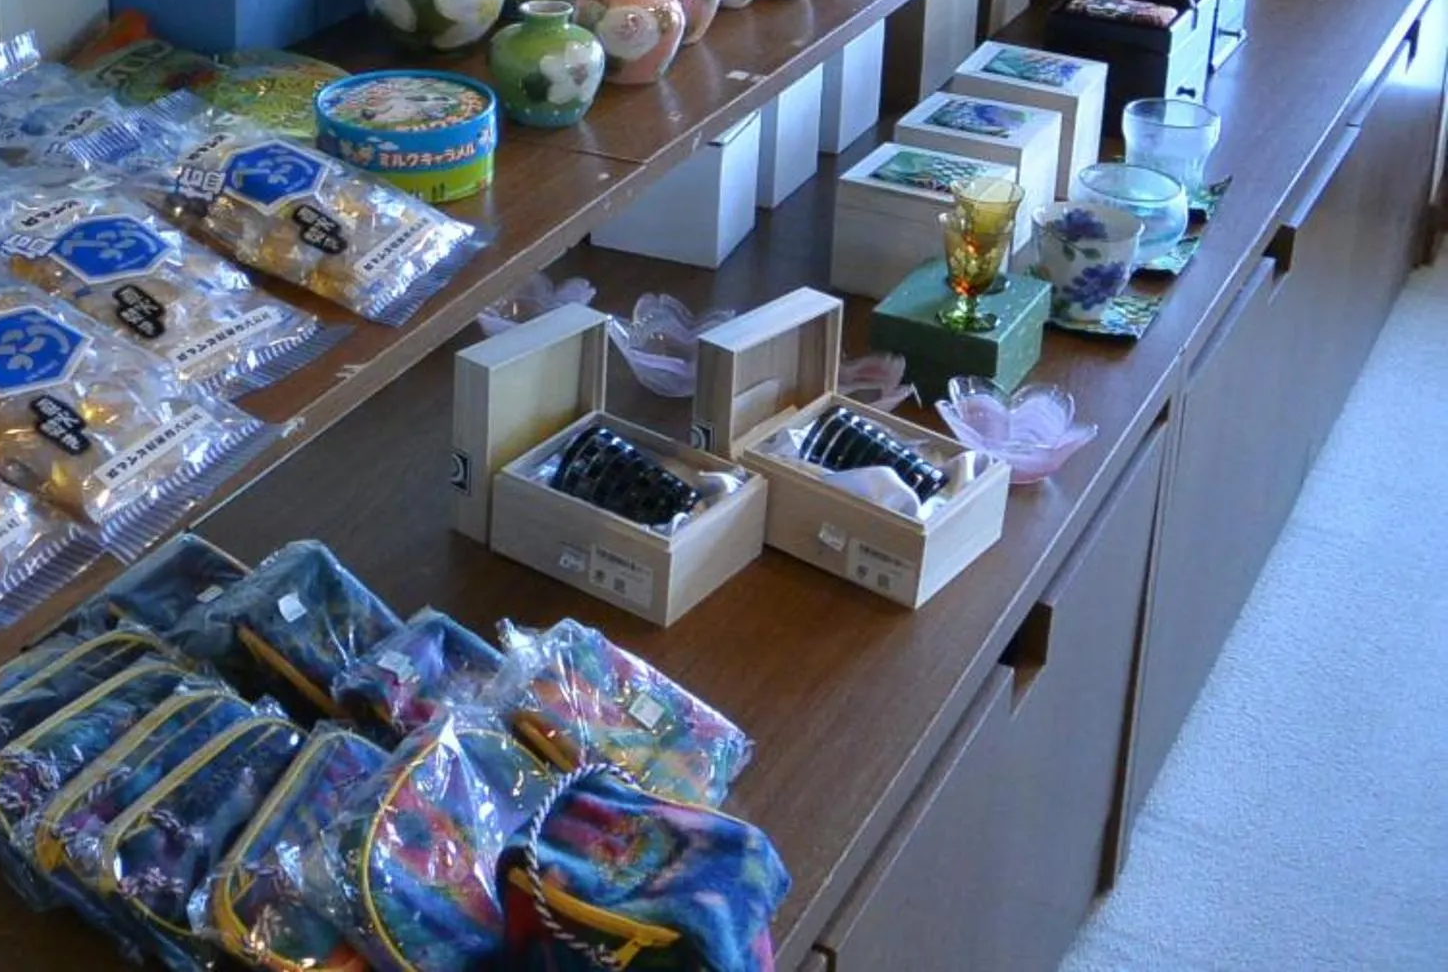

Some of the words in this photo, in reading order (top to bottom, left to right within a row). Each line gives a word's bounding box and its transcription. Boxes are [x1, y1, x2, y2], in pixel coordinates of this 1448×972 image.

[379, 141, 476, 168] ミルクキャラメル
[178, 166, 226, 202] 塩
